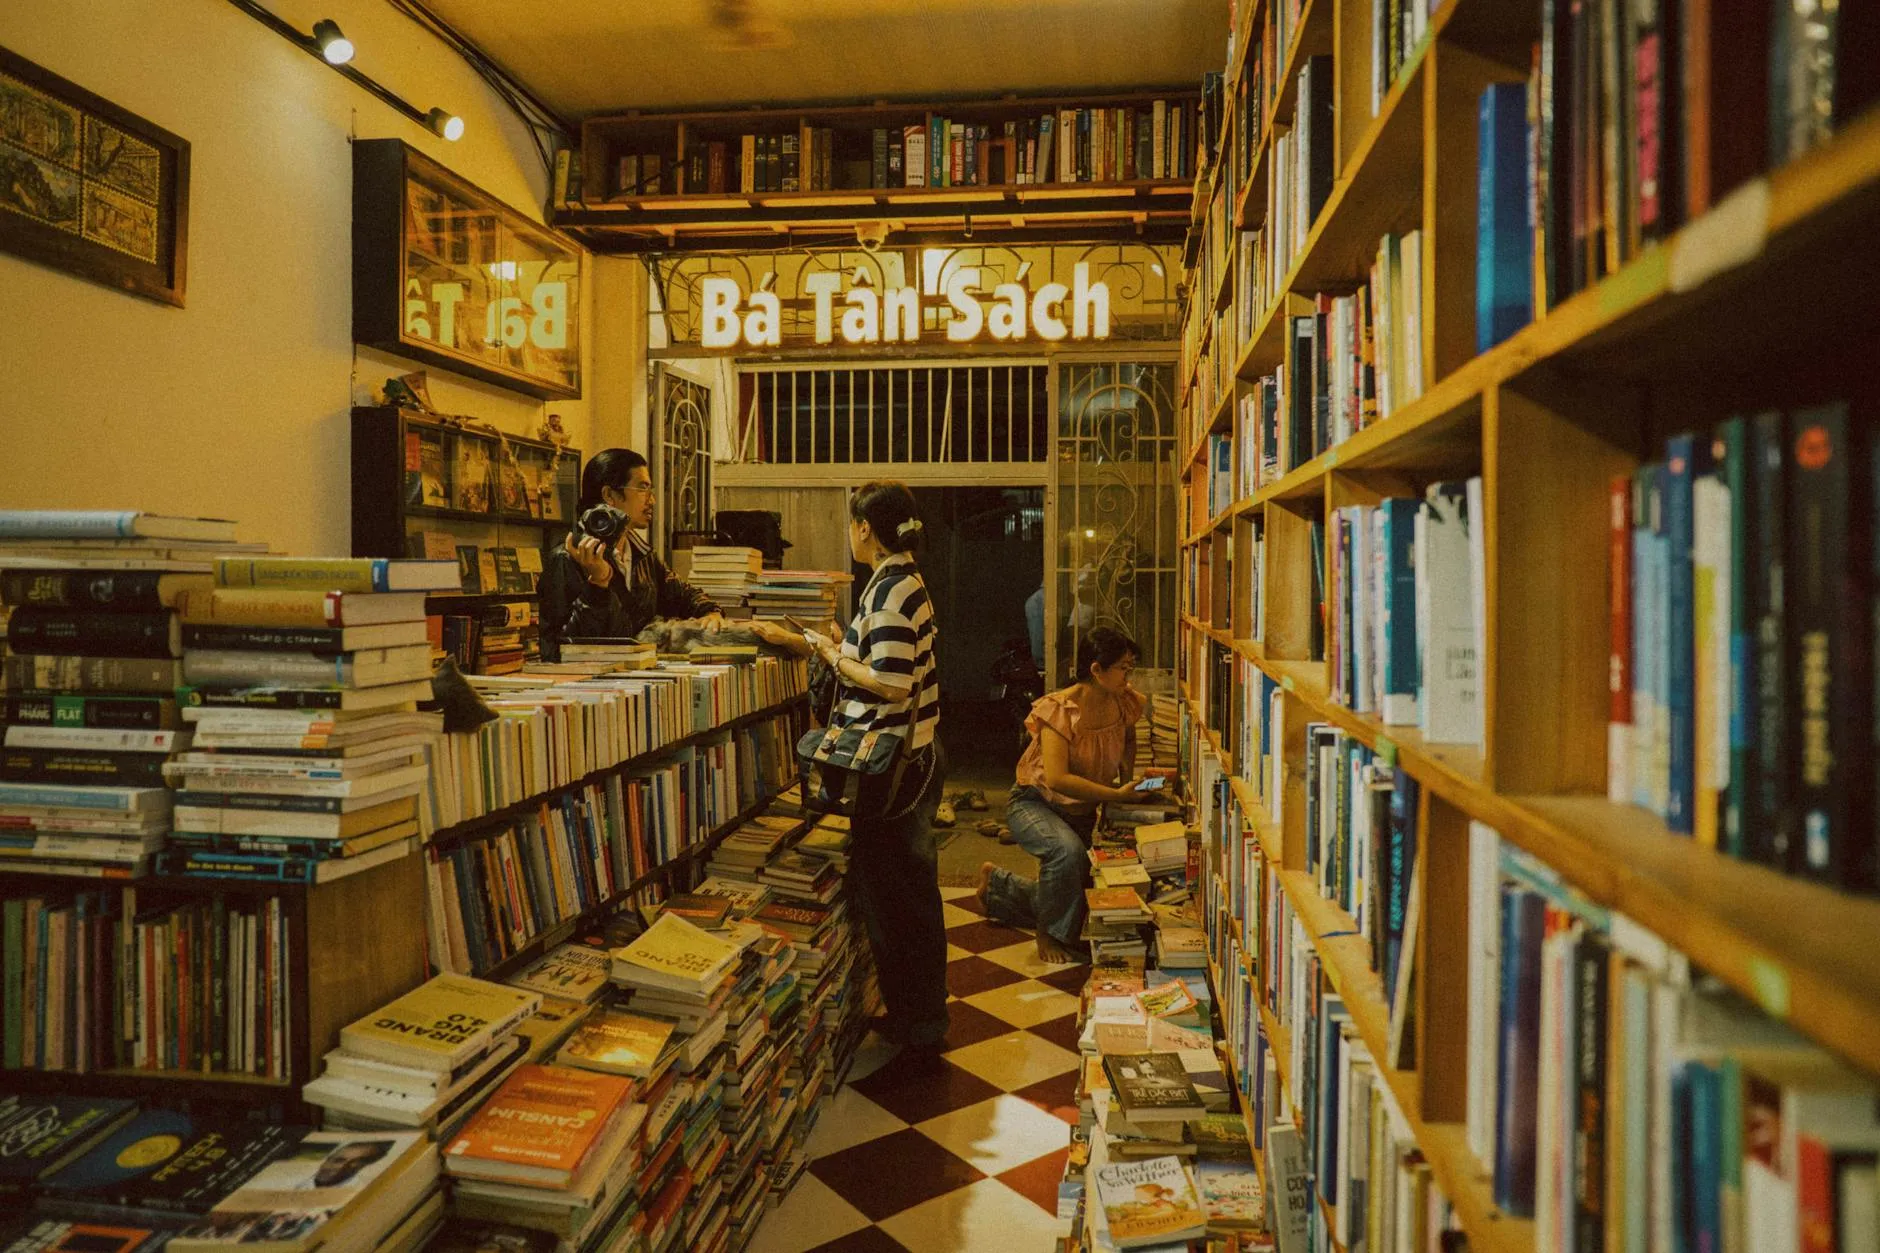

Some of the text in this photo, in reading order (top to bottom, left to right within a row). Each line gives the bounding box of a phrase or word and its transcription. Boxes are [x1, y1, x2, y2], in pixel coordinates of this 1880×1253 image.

[701, 261, 1111, 348] Bá Tân Sách
[56, 707, 81, 721] FLAT
[373, 1018, 467, 1045] BRAND
[432, 1020, 480, 1036] ING
[487, 1106, 586, 1129] CANSLIM
[1098, 1159, 1172, 1181] Charlotte
